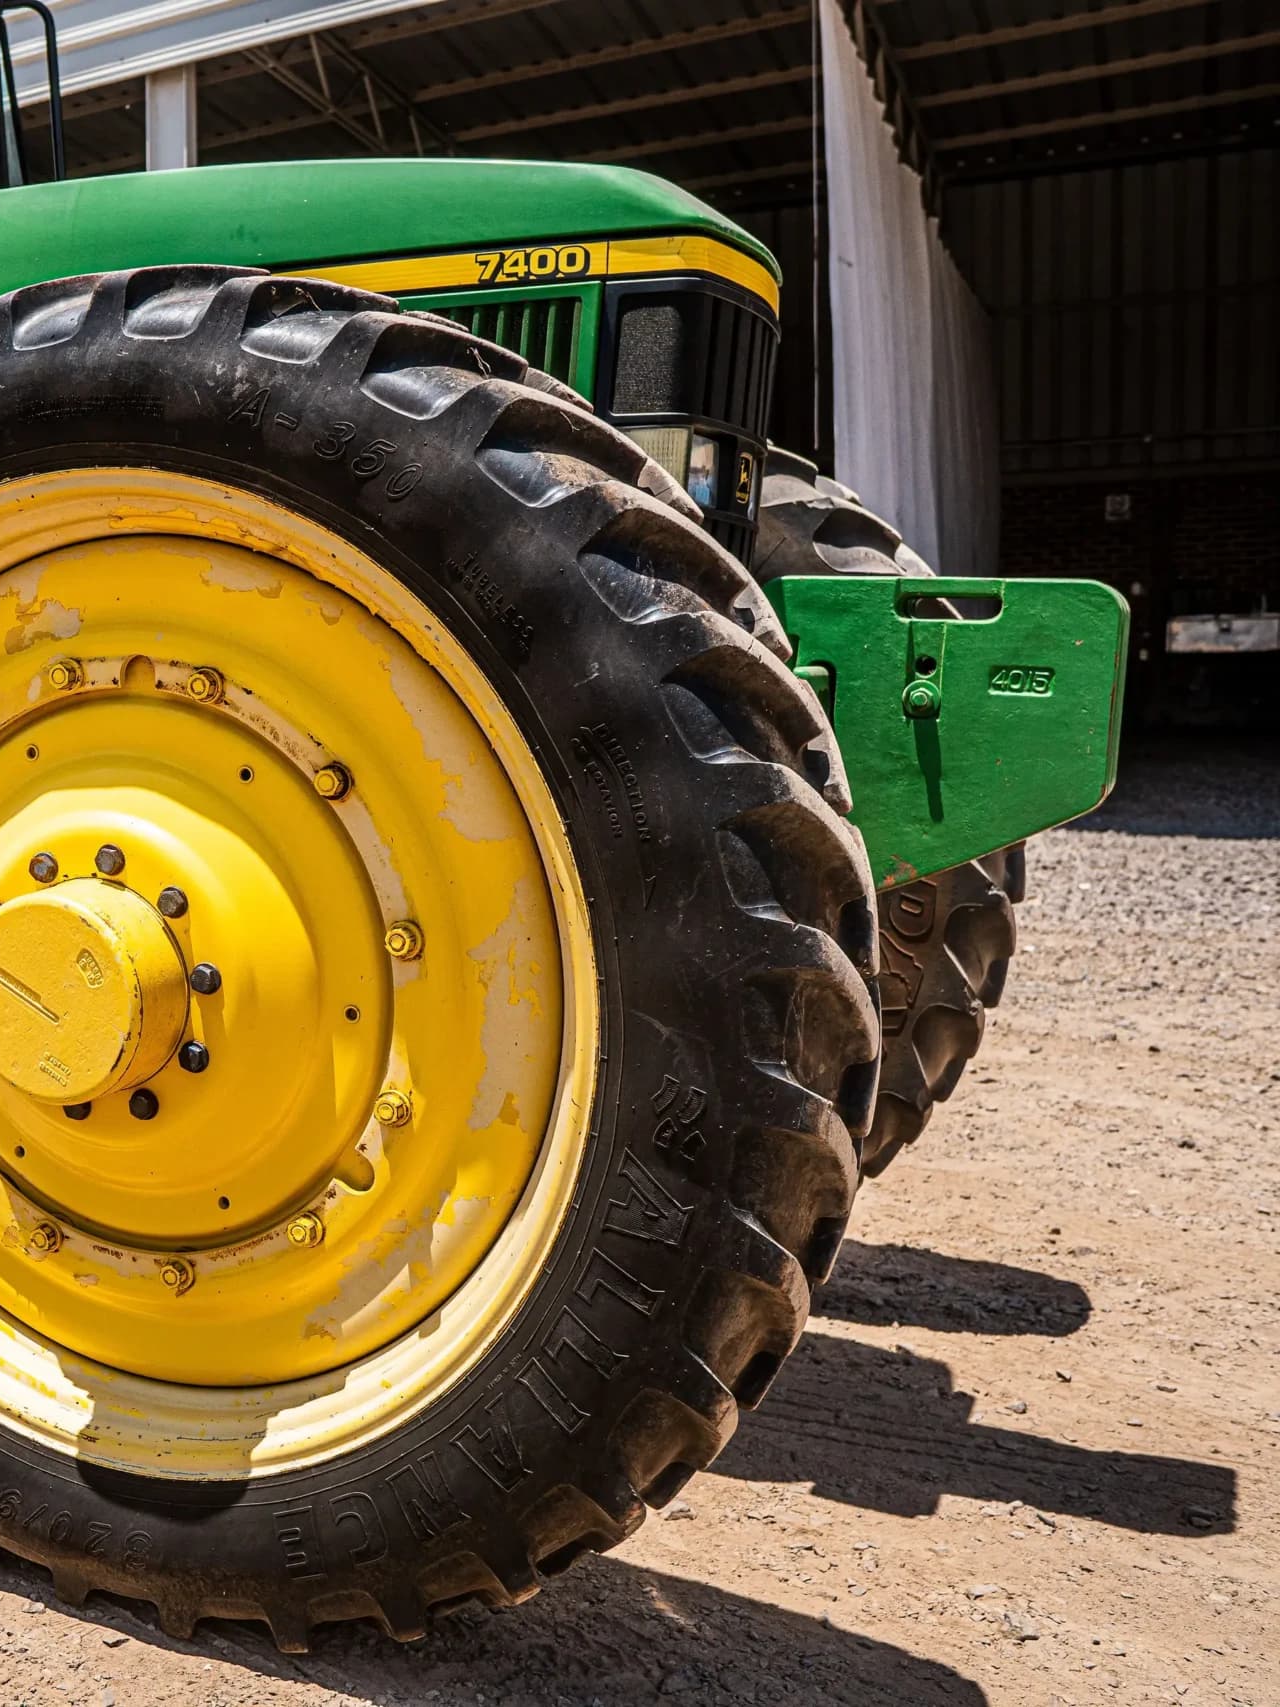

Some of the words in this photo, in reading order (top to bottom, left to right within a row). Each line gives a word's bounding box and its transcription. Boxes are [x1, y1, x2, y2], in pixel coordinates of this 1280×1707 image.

[475, 246, 589, 282] 7400
[226, 386, 424, 499] A-350
[990, 669, 1054, 693] 4015
[592, 722, 651, 841] DIRECTION
[272, 1147, 695, 1582] ALLIANCE
